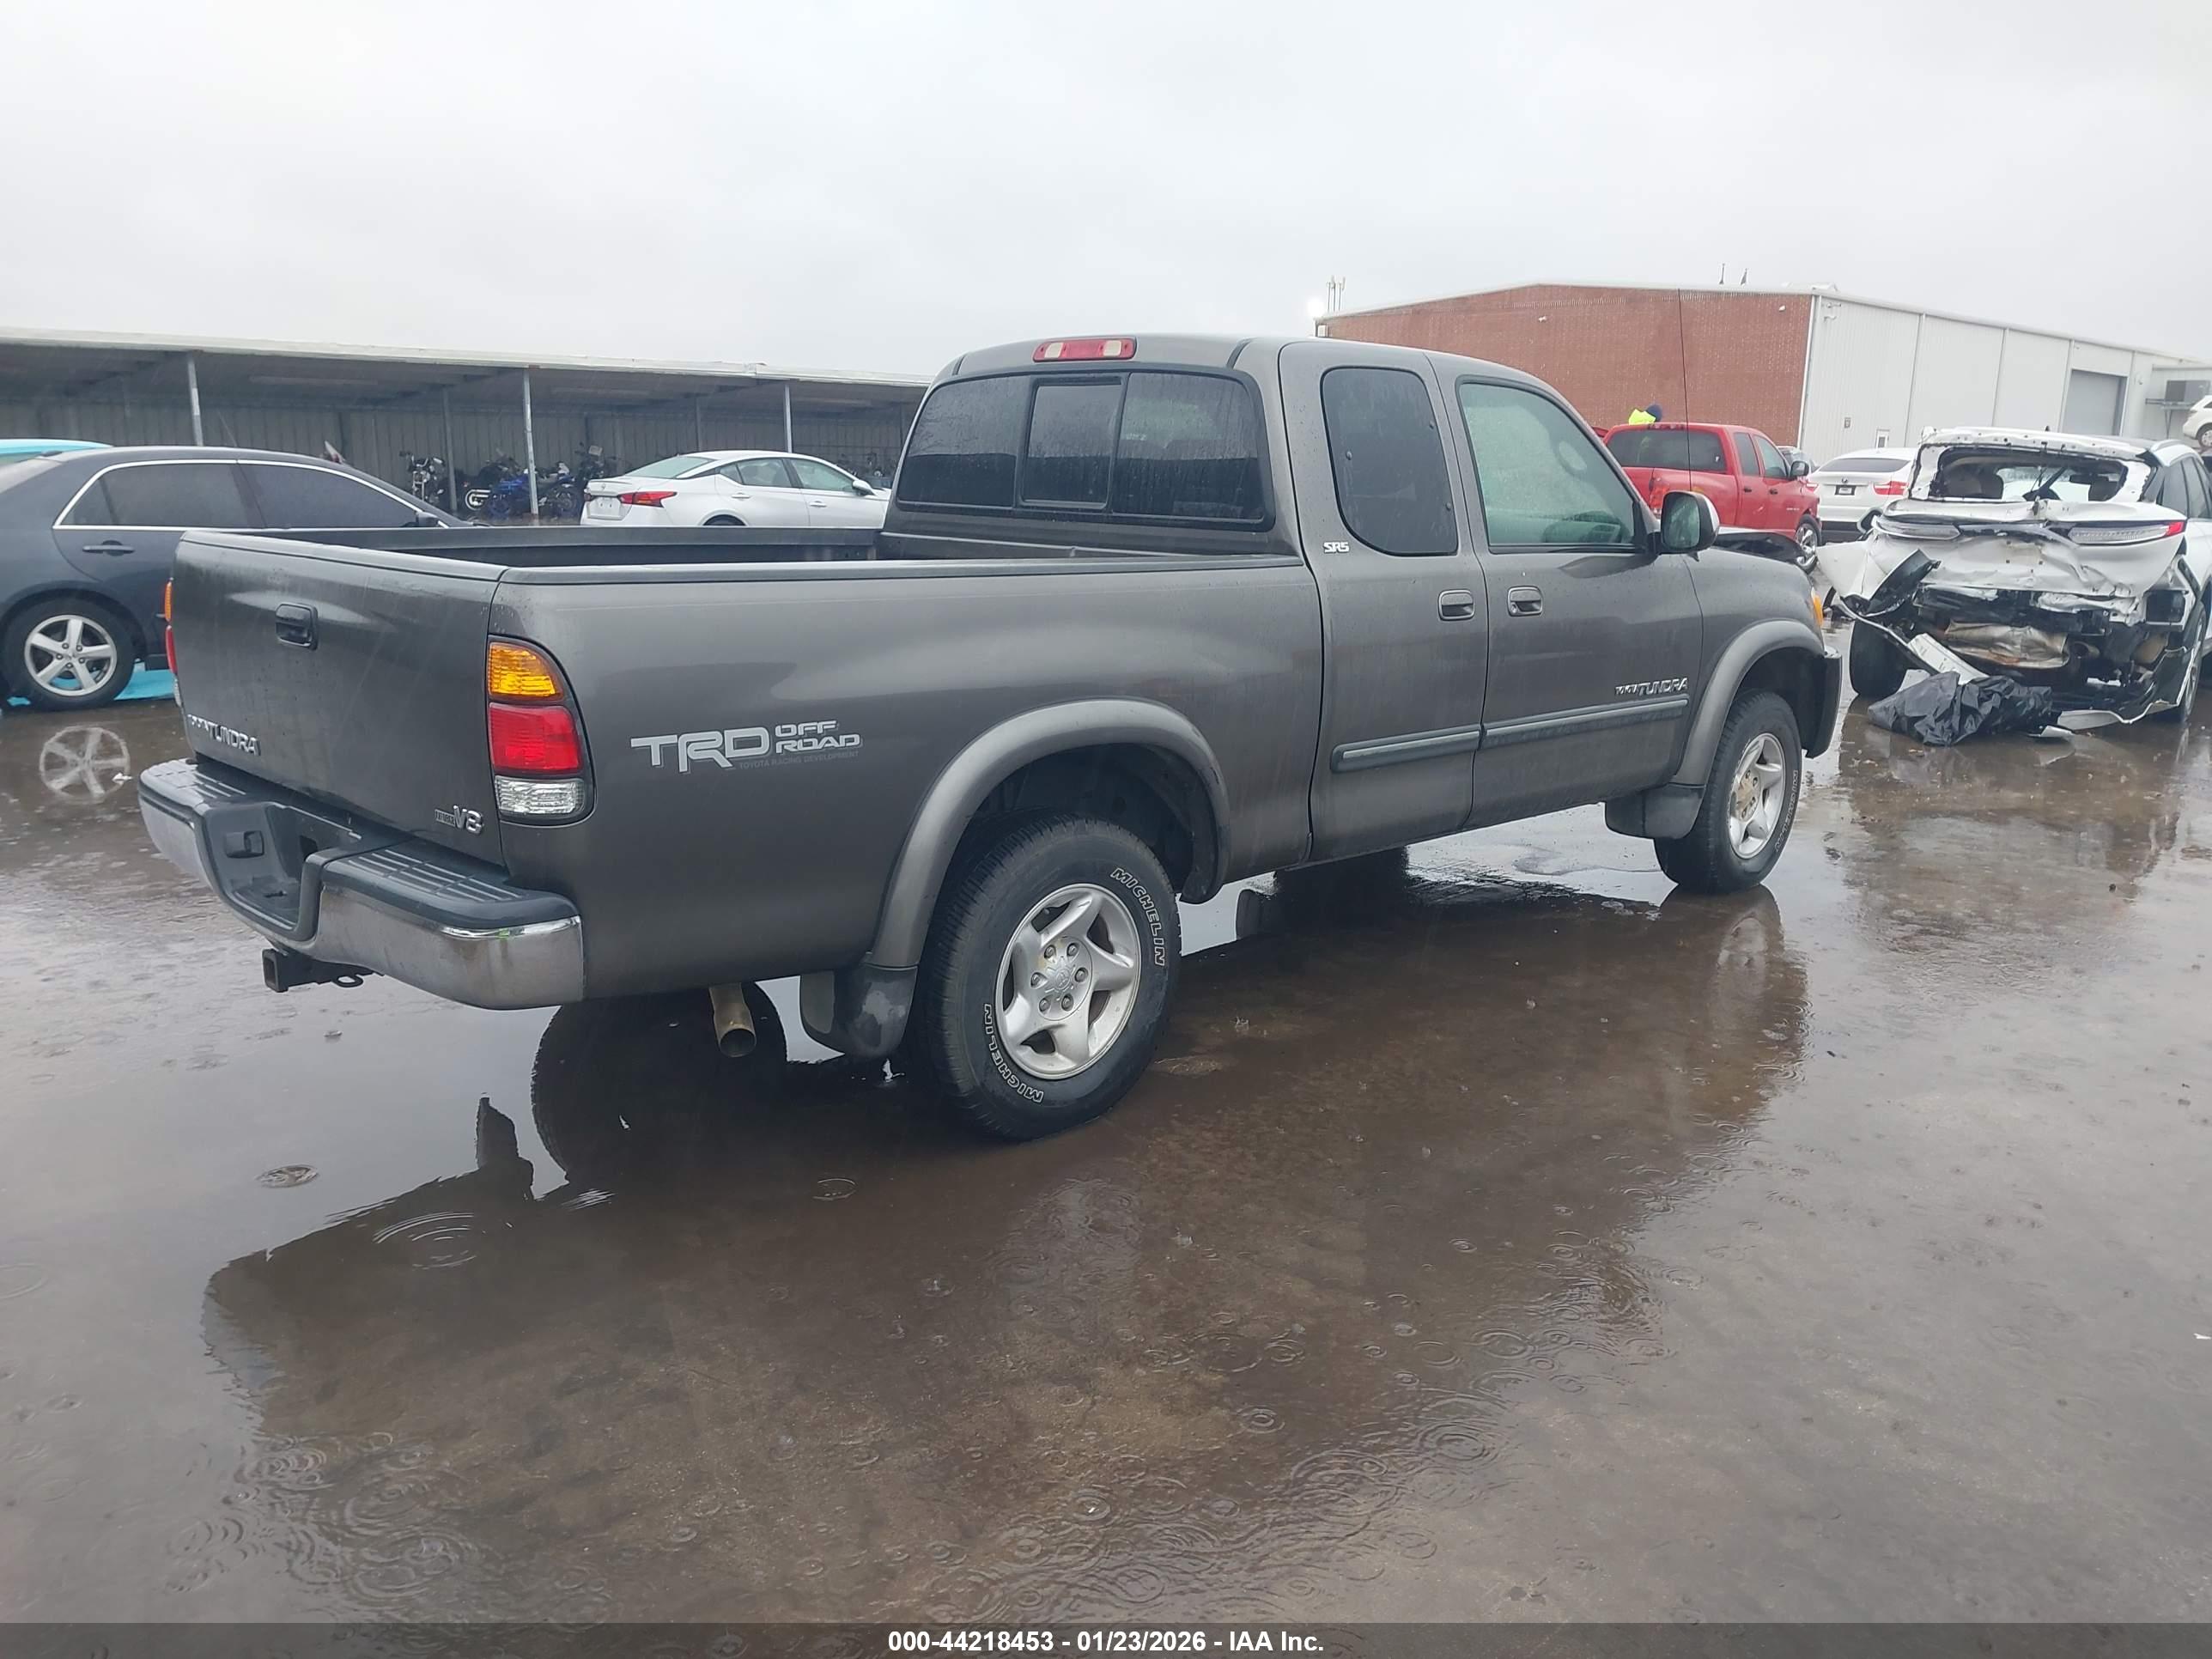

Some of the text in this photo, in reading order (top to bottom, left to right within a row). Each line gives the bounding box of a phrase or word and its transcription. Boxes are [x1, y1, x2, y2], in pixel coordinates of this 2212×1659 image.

[1323, 542, 1349, 553] SR5
[1638, 677, 1689, 696] TUNDRA
[206, 720, 261, 756] TUNDRA
[775, 720, 839, 738] OFF
[630, 726, 770, 773] TRD
[775, 733, 862, 754] ROAD
[738, 750, 860, 770] TOYOTA RACING DEVELOPMENT
[453, 805, 484, 835] V8
[1109, 867, 1165, 967] MICHELIN
[983, 1003, 1044, 1103] MICHELIN
